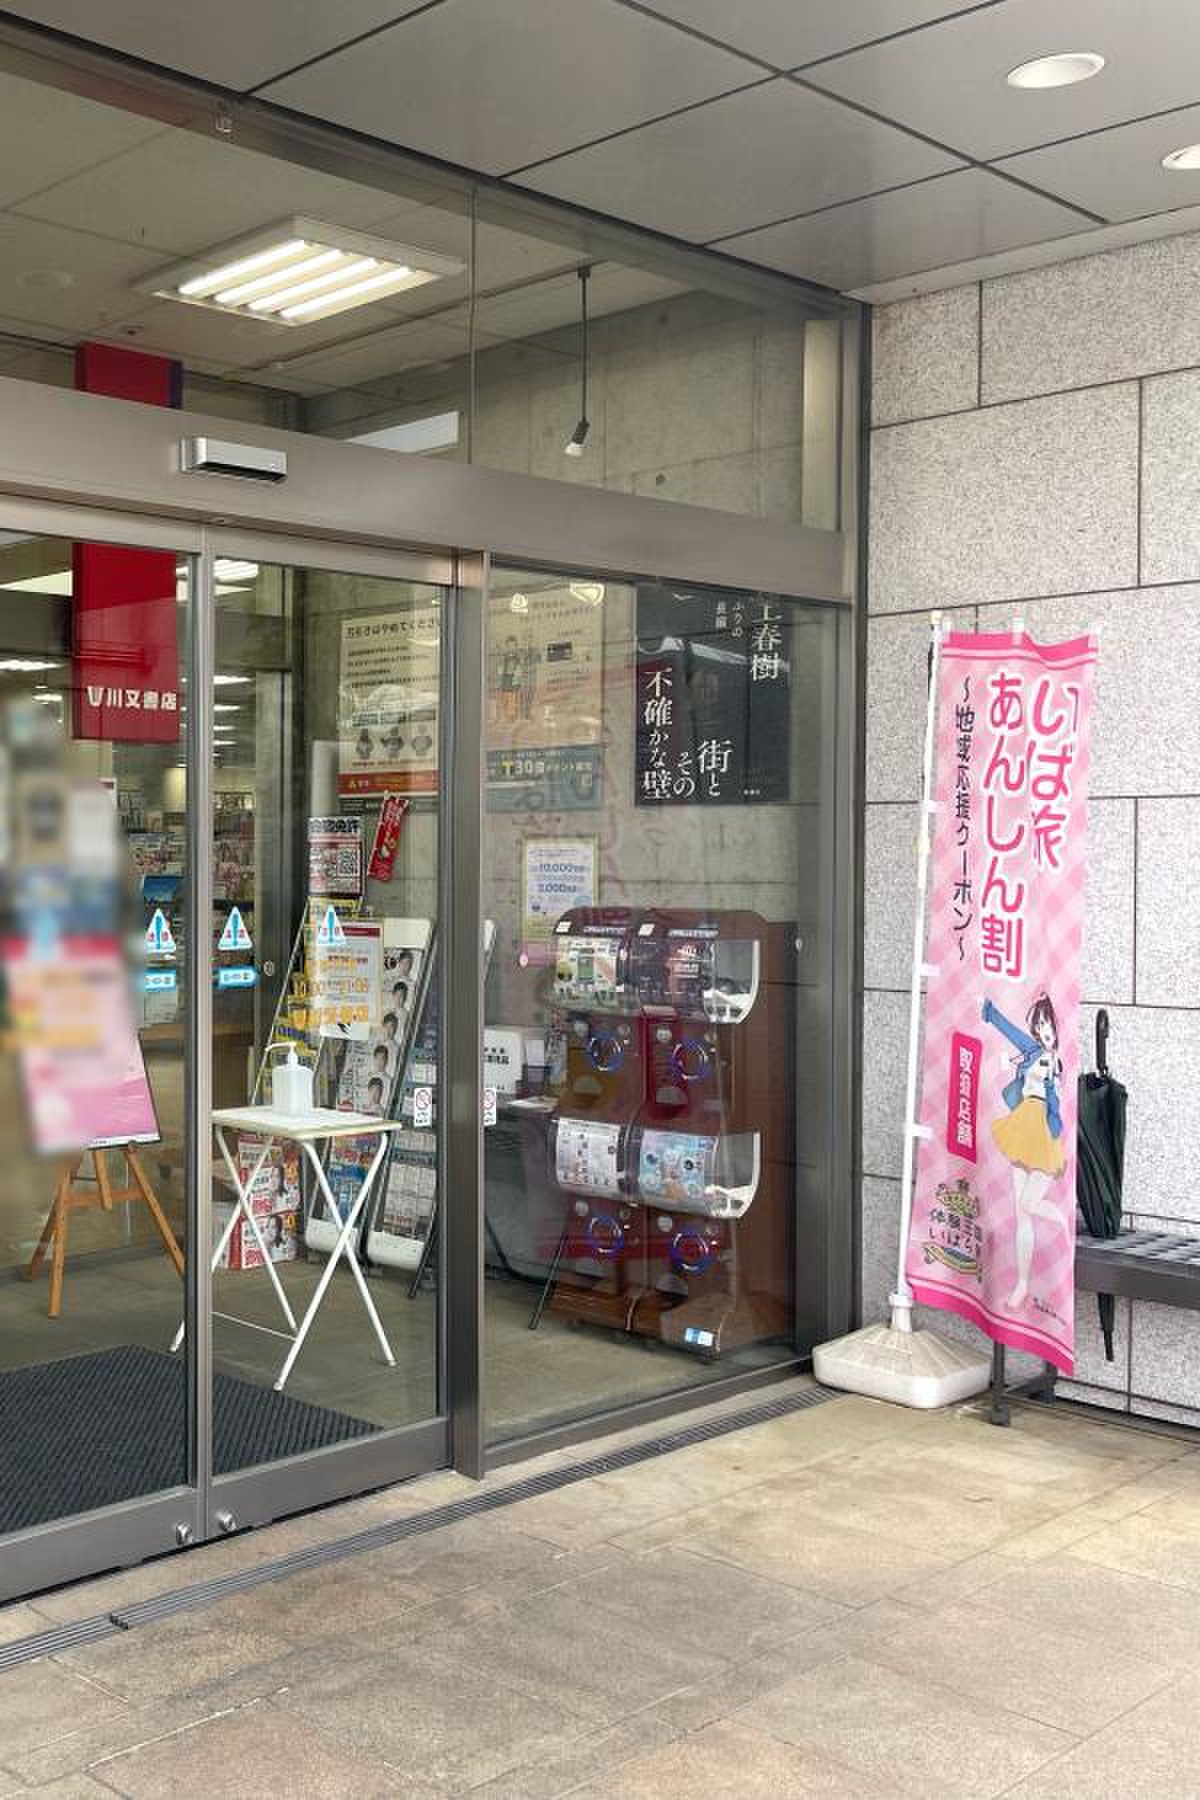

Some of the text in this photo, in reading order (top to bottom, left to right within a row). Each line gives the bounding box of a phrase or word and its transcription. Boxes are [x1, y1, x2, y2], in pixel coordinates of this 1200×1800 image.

[643, 667, 673, 799] 不確かな壁
[673, 751, 696, 798] その
[697, 739, 733, 797] 街と
[980, 671, 1025, 977] あんしん割
